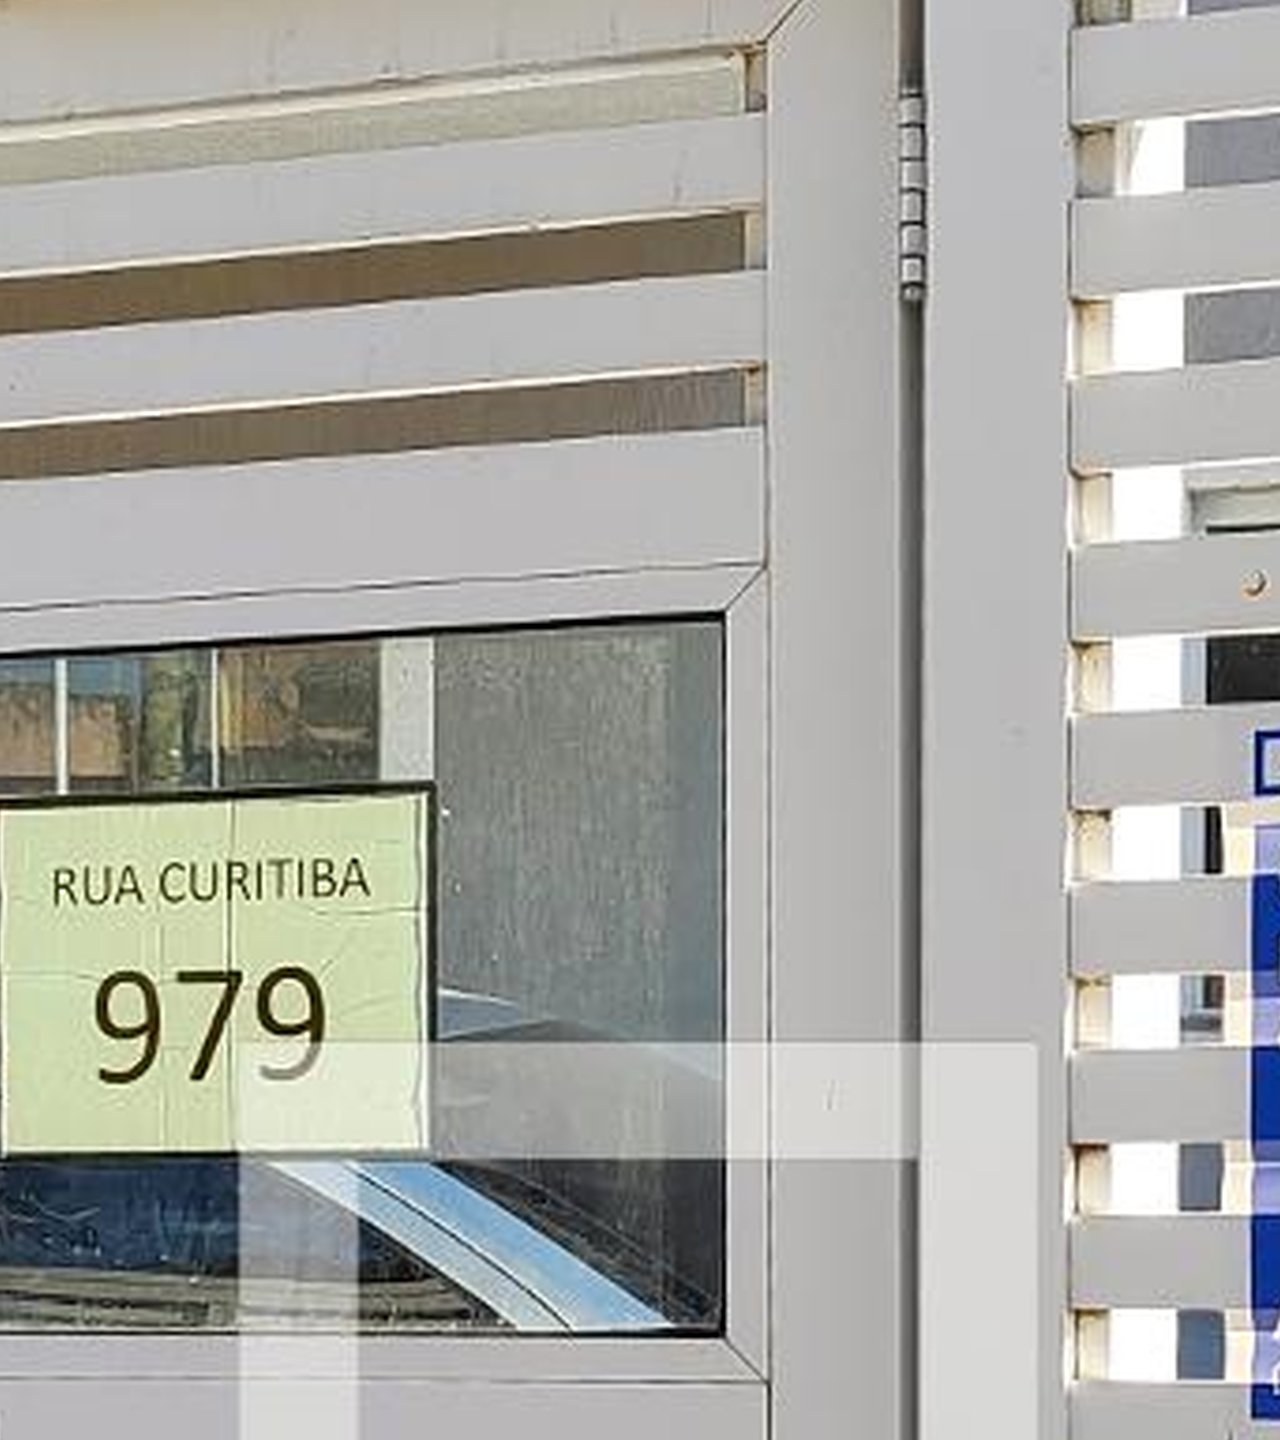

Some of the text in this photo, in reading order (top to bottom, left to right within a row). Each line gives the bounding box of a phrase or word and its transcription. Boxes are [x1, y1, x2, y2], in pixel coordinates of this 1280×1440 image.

[52, 857, 371, 906] RUA CURITIBA
[94, 966, 327, 1085] 979
